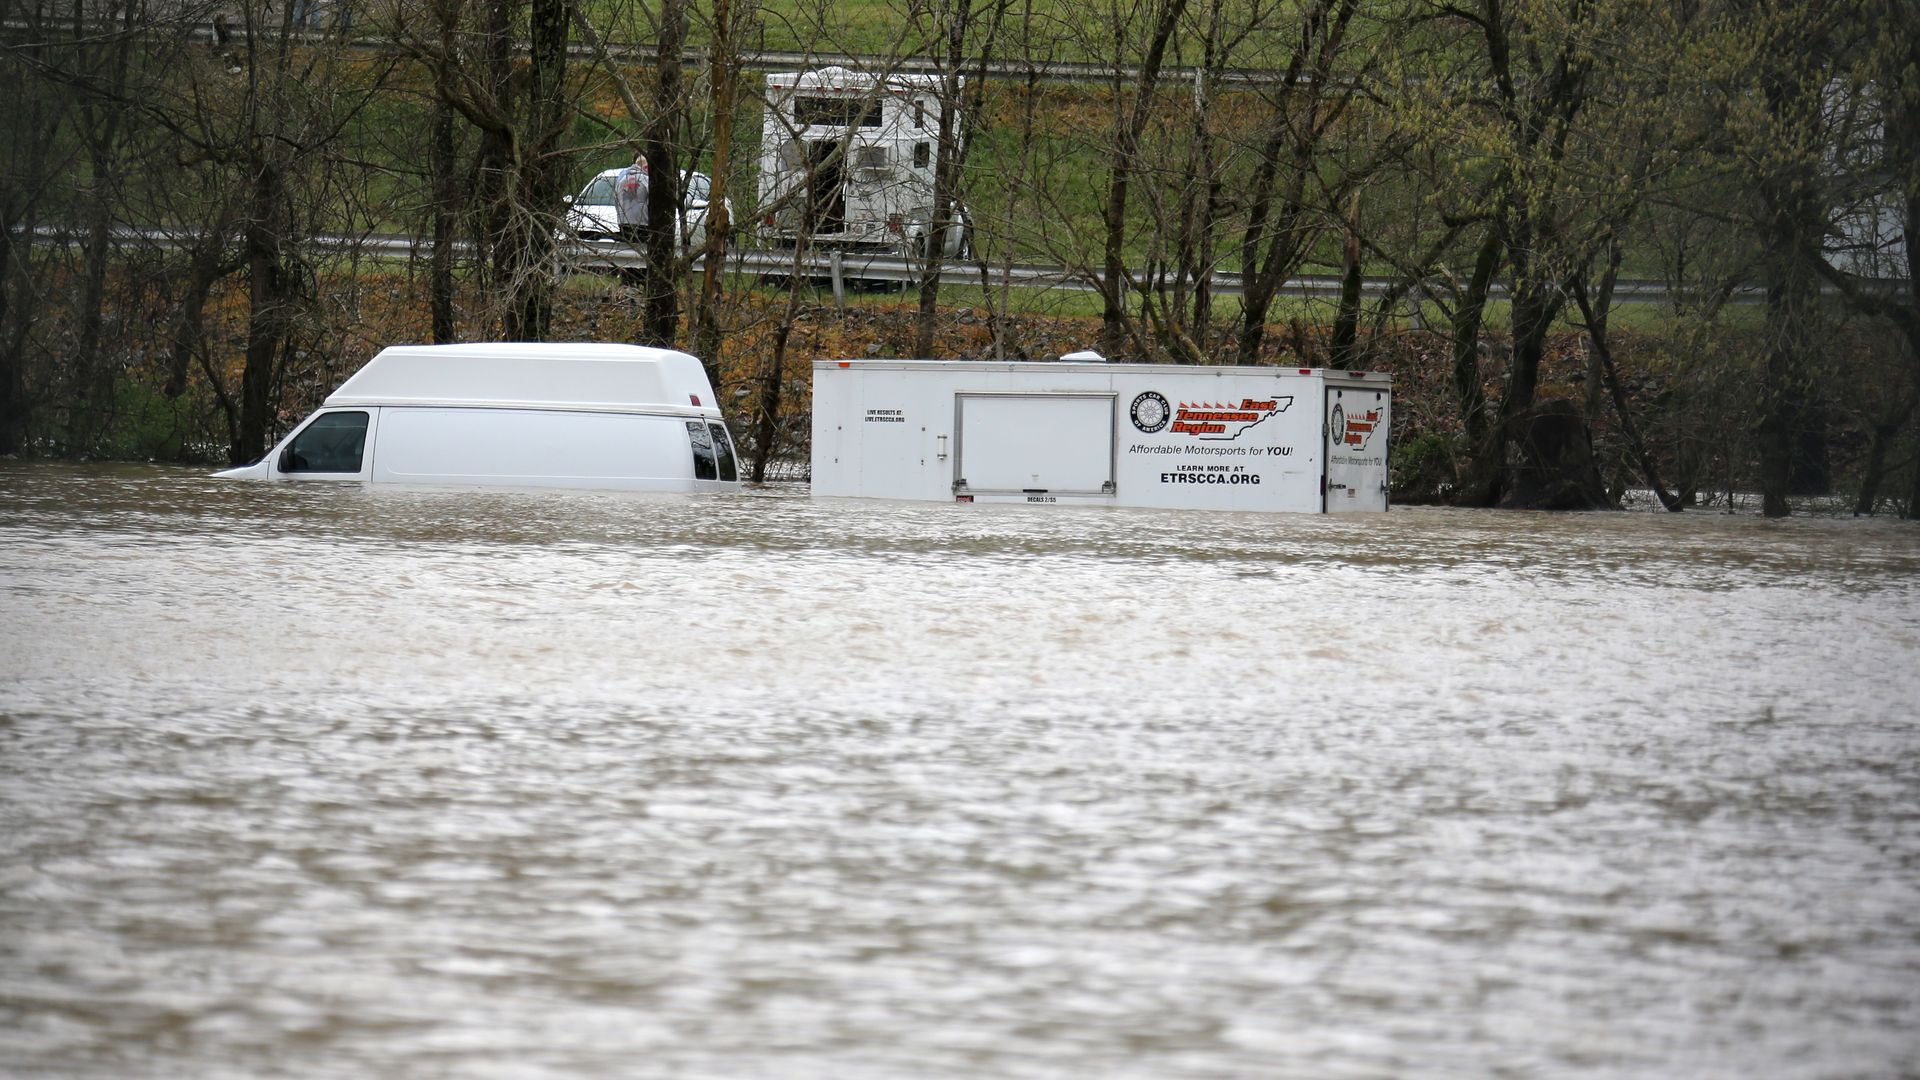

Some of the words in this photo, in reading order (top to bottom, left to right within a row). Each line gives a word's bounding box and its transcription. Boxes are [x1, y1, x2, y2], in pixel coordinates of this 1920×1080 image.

[1131, 394, 1147, 415] SPORTS
[1160, 399, 1169, 415] CLUB
[1239, 399, 1278, 411] East
[1176, 409, 1259, 422] Tennessee
[1142, 420, 1167, 432] AMERICA
[1170, 421, 1227, 436] Region
[1129, 444, 1182, 455] Affordable
[1184, 445, 1247, 457] Motorsports
[1249, 446, 1264, 456] for
[1266, 446, 1294, 456] YOU!
[1160, 473, 1261, 485] ETRSCCA.ORG
